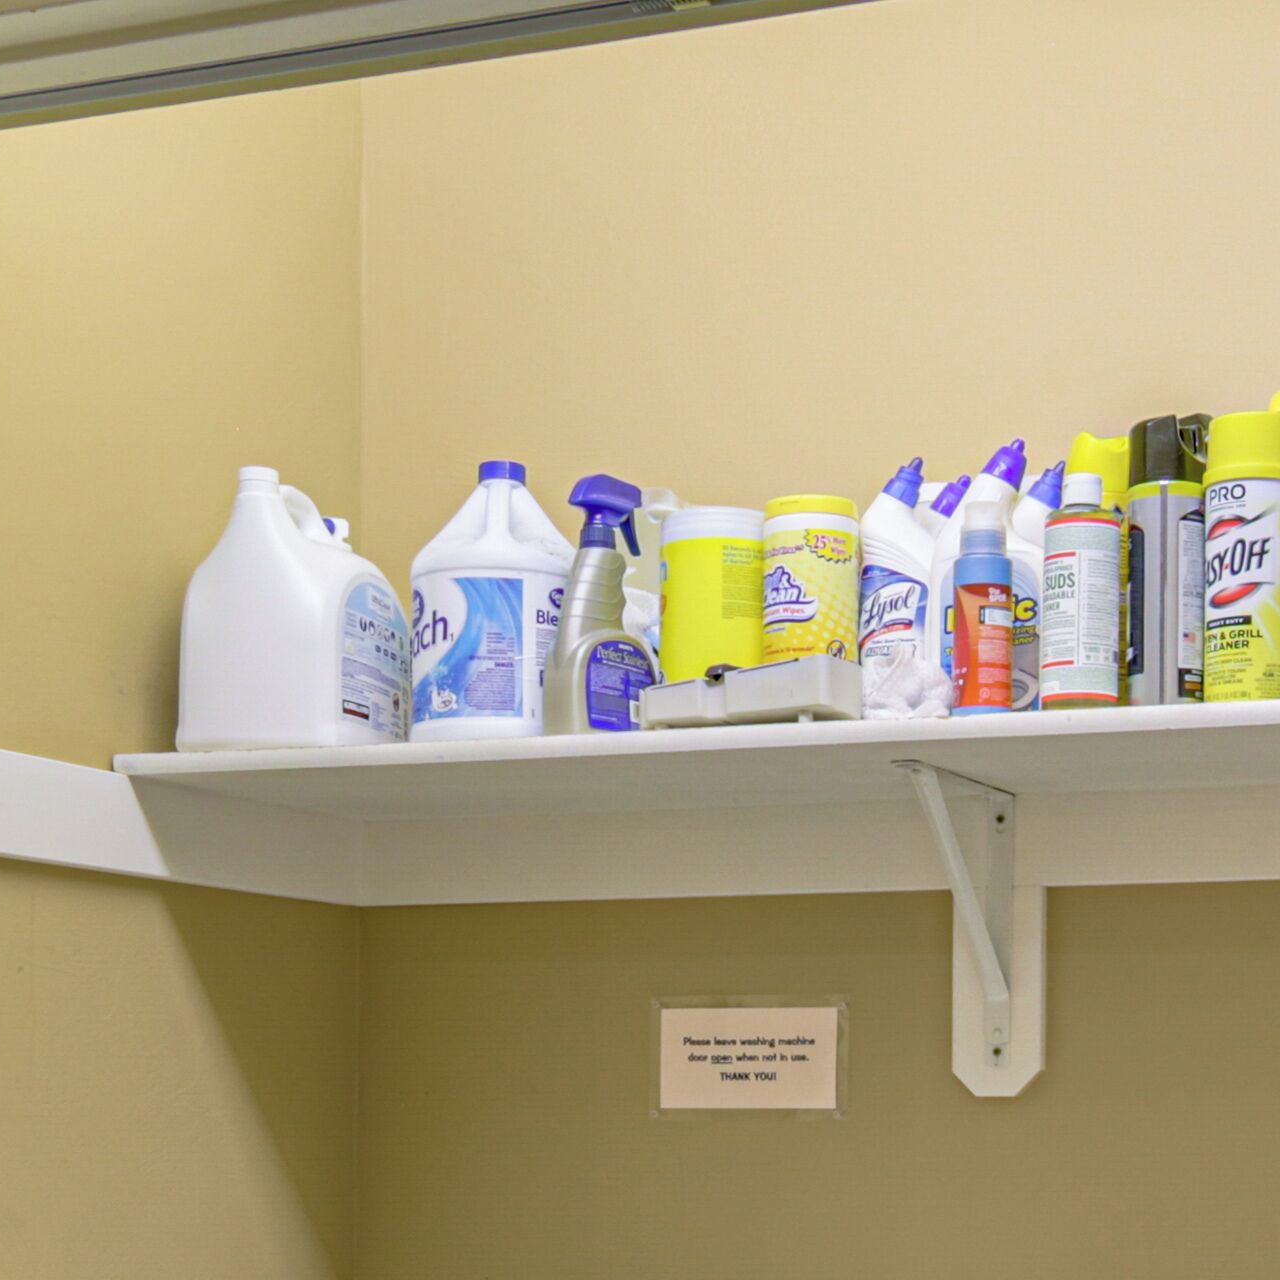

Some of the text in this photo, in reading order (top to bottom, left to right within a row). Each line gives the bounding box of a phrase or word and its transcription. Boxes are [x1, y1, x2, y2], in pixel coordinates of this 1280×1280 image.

[1209, 483, 1246, 505] PRO
[1046, 572, 1075, 591] SUDS
[863, 585, 916, 629] Lysol
[1229, 629, 1263, 639] GRILL
[683, 1036, 816, 1048] Please leave washing machine
[687, 1053, 708, 1061] door
[711, 1055, 733, 1064] open
[735, 1053, 759, 1061] when
[762, 1053, 777, 1061] not
[779, 1053, 788, 1061] in
[720, 1072, 777, 1081] THANK YOU!
